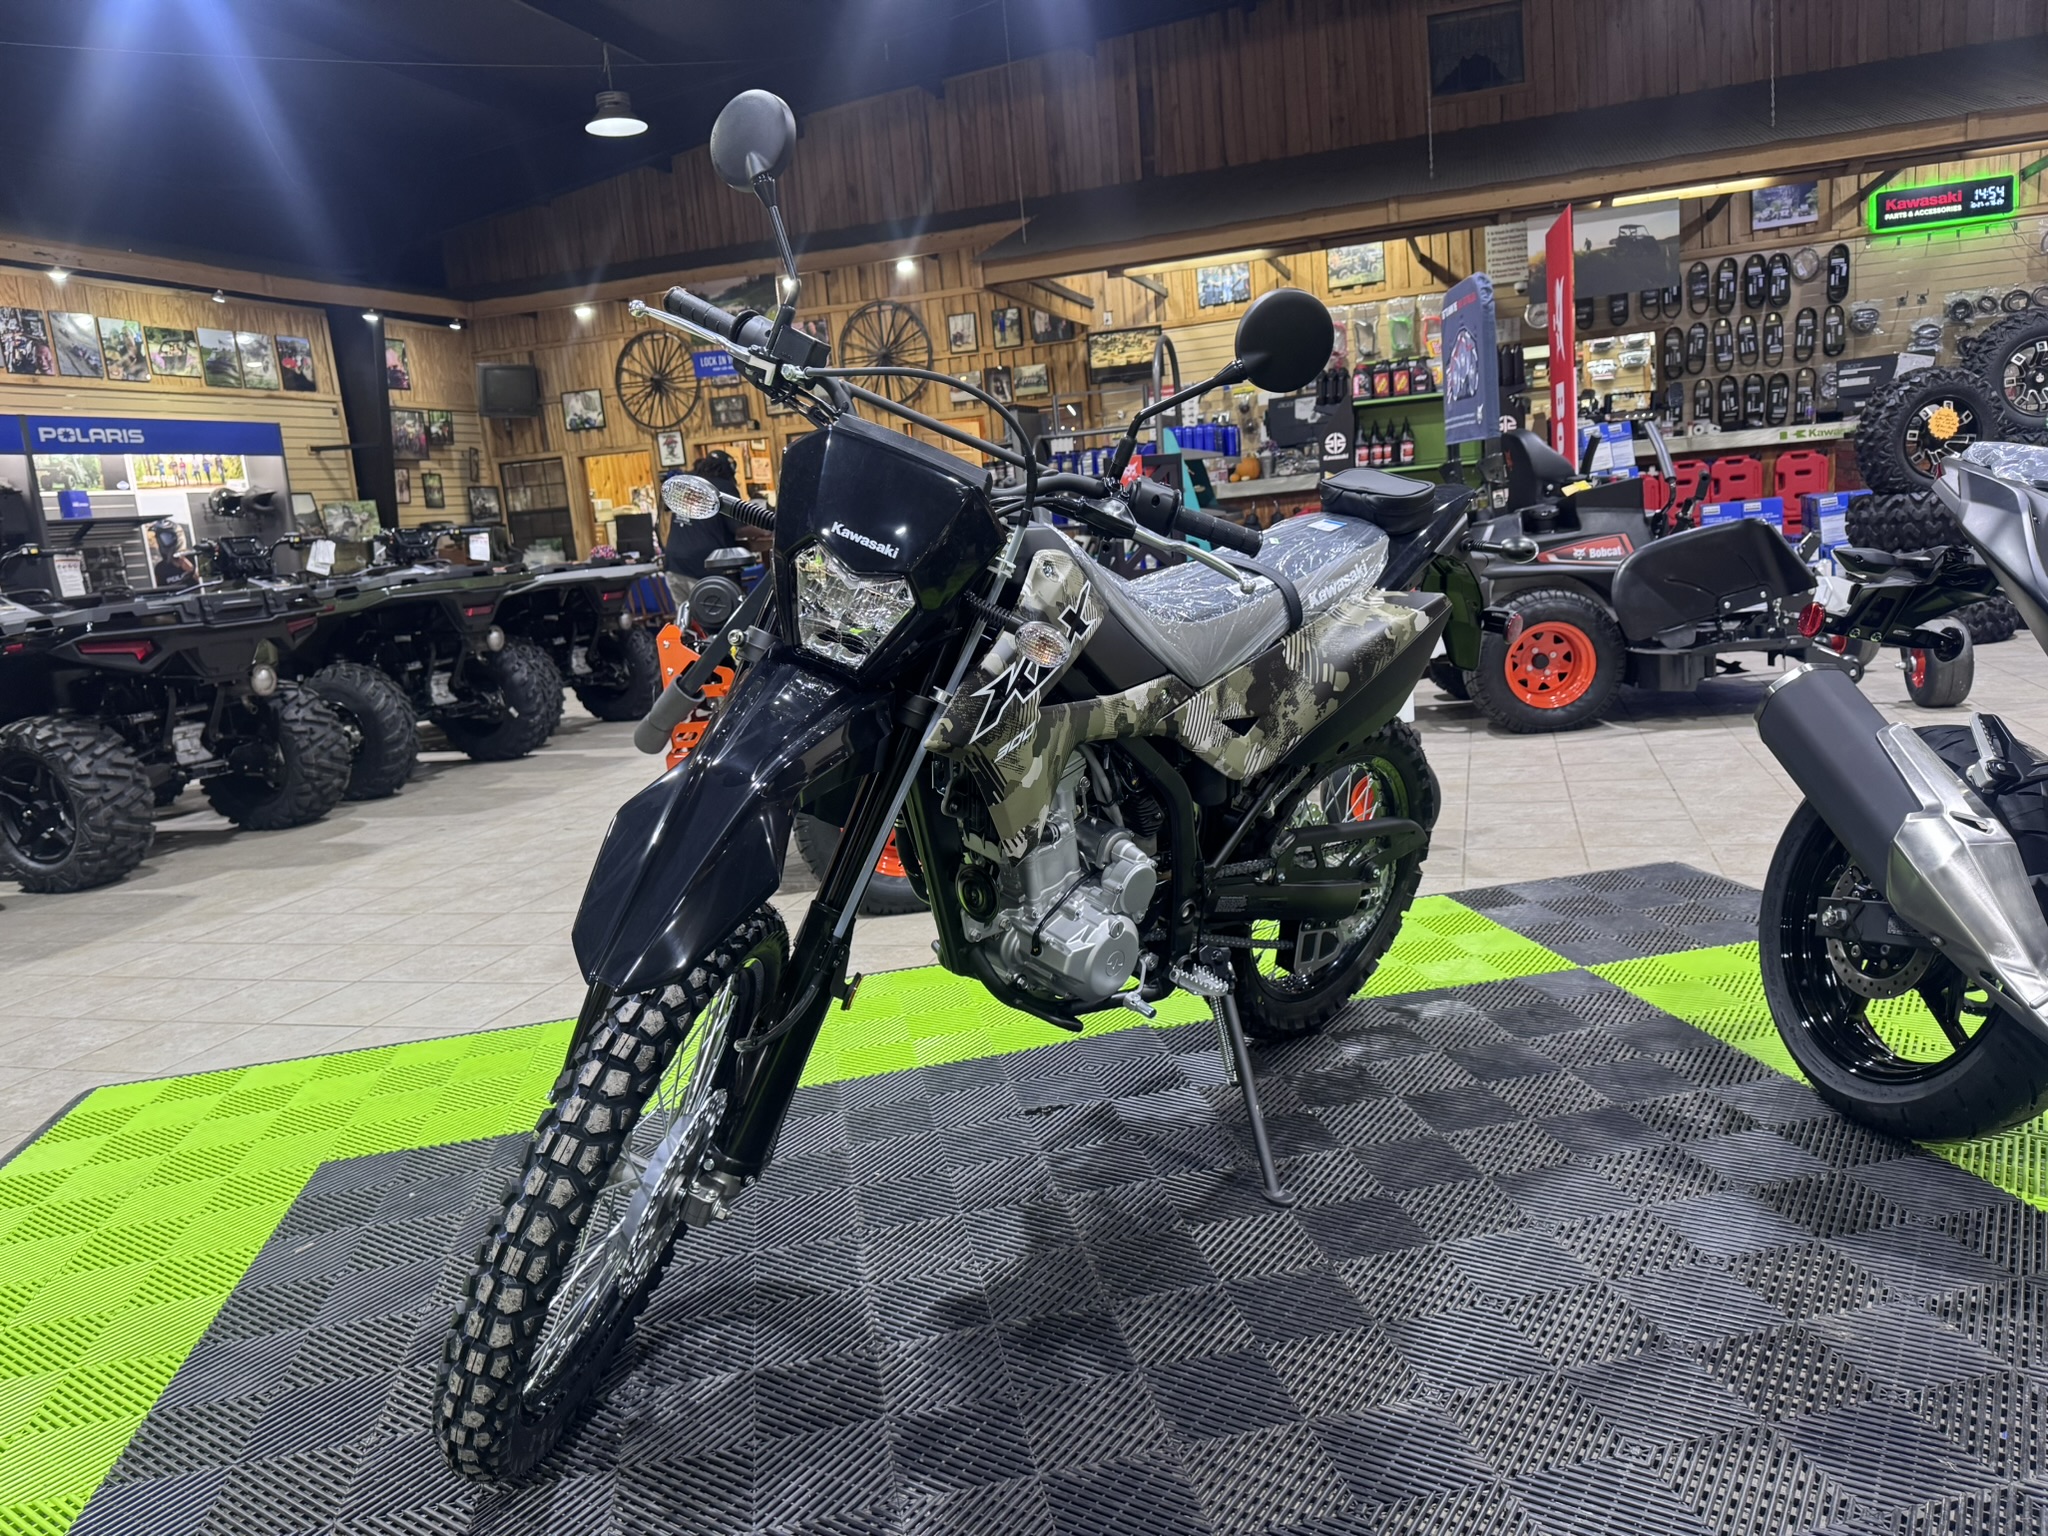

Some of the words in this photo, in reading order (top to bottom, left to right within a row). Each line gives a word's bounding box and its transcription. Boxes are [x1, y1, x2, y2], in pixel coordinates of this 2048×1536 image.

[1885, 190, 1963, 211] Kawasaki
[1974, 185, 2005, 201] 14:54
[1884, 211, 1907, 220] PARTS
[1908, 210, 1914, 218] &
[1914, 204, 1962, 217] ACCESSORIES
[700, 355, 717, 368] LOCK
[38, 427, 145, 444] POLARIS
[831, 521, 900, 559] Kawasaki
[1589, 546, 1622, 558] Bobcat
[1308, 559, 1368, 610] Kawasaki
[994, 719, 1037, 764] 300
